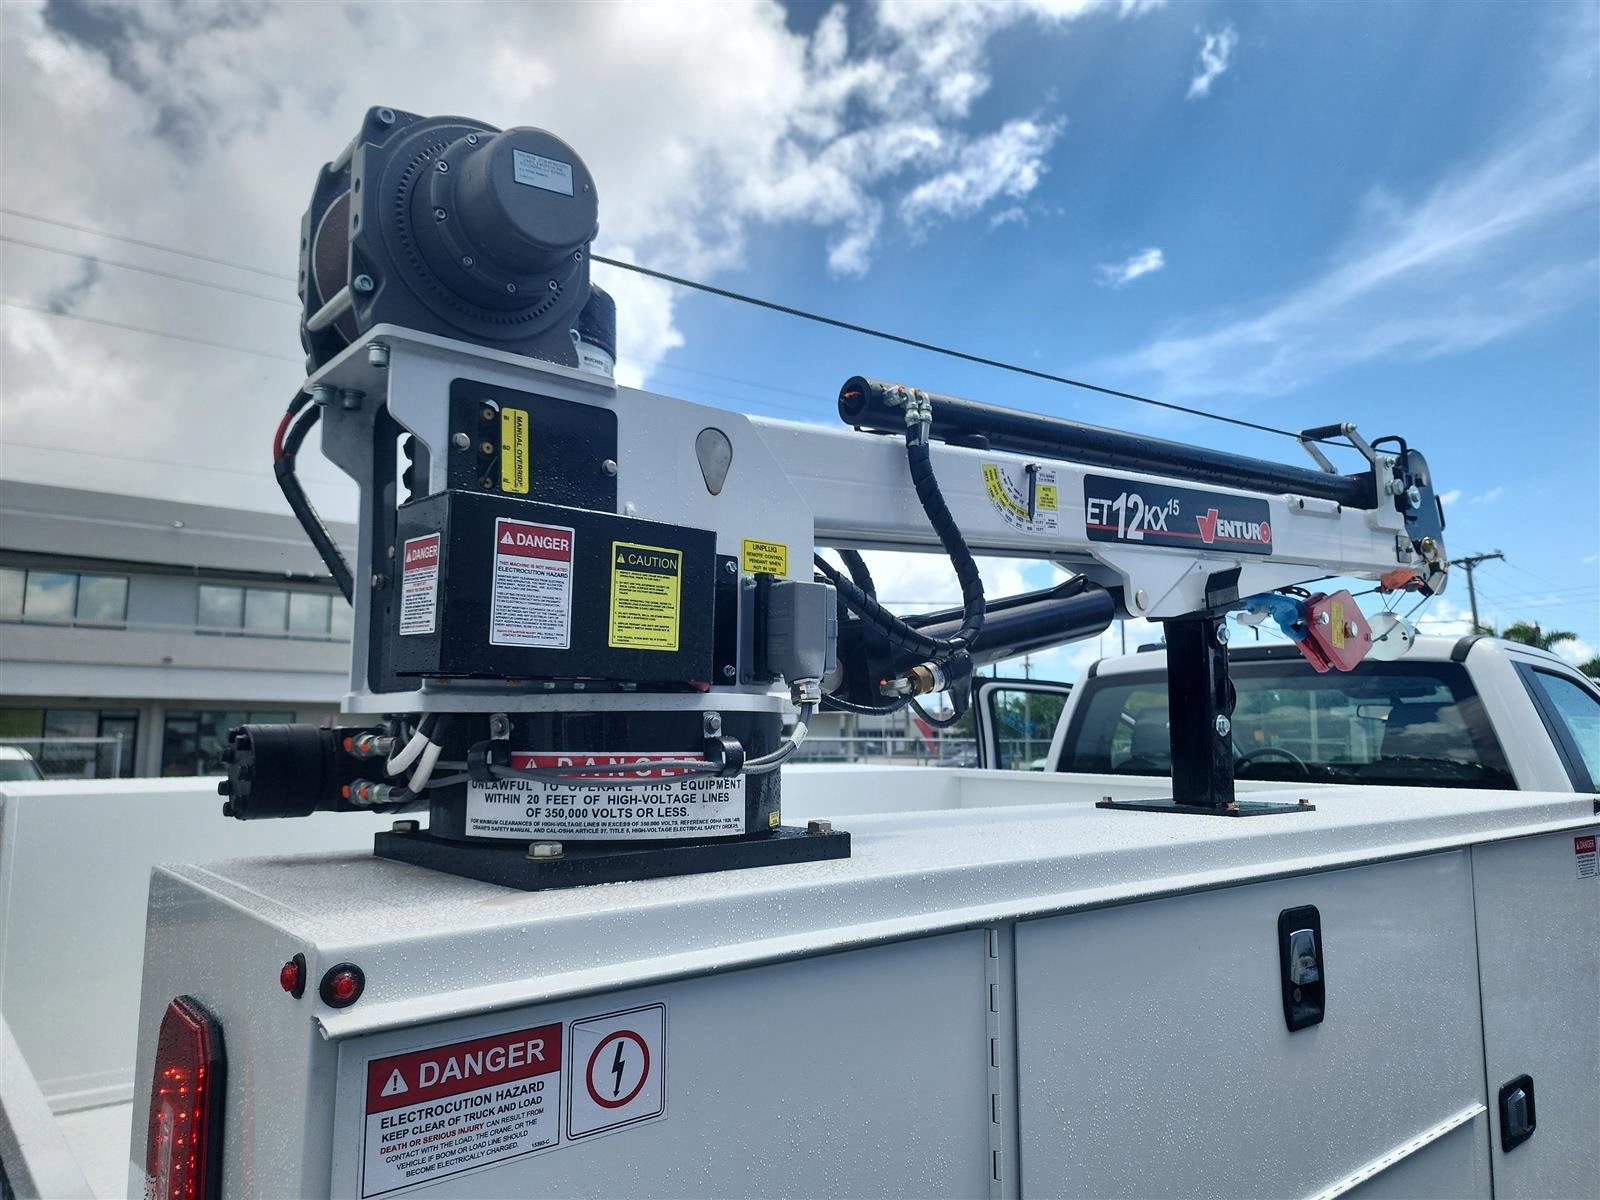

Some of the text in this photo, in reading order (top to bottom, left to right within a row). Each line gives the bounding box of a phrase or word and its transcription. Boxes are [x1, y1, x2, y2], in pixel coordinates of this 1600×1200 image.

[1196, 508, 1271, 544] VENTURO
[411, 545, 438, 561] DANGER
[516, 533, 569, 552] DANGER
[752, 544, 777, 553] UNPLUG
[498, 566, 545, 576] ELECTROCUTION
[628, 554, 677, 570] CAUTION
[471, 780, 532, 791] UNLAWFUL
[680, 779, 741, 791] EQUIPMENT
[485, 792, 730, 805] WITHIN 20 FEET OF HIGH-VOLTAGE LINES
[526, 807, 690, 820] OF 350,000 VOLTS OR LESS.
[418, 1038, 545, 1088] DANGER
[380, 1081, 545, 1129] ELECTROCUTION HAZARD
[380, 1108, 544, 1155] DEATH OR SERIOUS INJURY CAN RESULT FROM
[381, 1096, 543, 1143] KEEP CLEAR OF TRUCK AND LOAD
[385, 1118, 538, 1164] CONTACT WITH THE LOAD, THE CRANE, OR THE
[396, 1130, 528, 1170] VEHICLE IF BOOM OR LOAD LINE SHOULD
[406, 1142, 519, 1177] BECOME ELECTRICALLY CHARGED.
